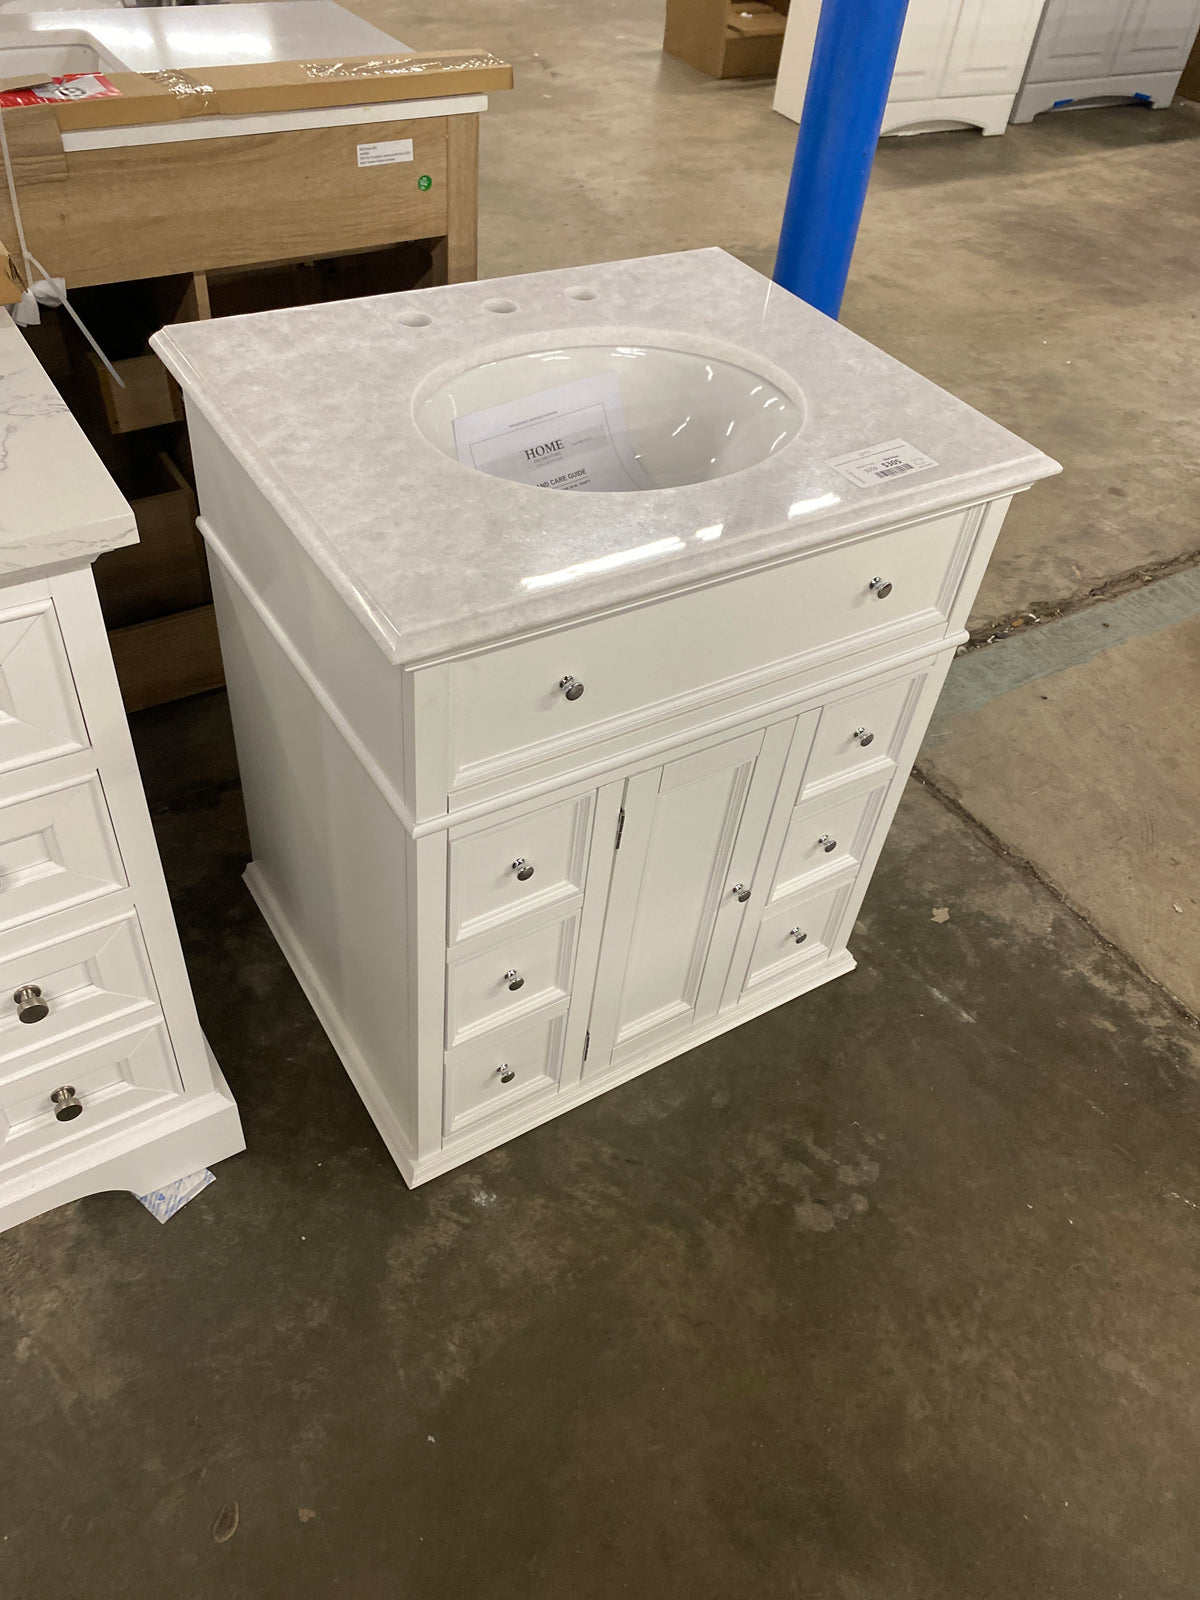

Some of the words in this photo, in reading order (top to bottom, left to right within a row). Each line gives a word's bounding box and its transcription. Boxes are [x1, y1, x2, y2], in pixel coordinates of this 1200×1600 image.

[524, 439, 565, 460] HOME
[550, 475, 567, 486] CARE
[567, 468, 587, 479] GUIDE
